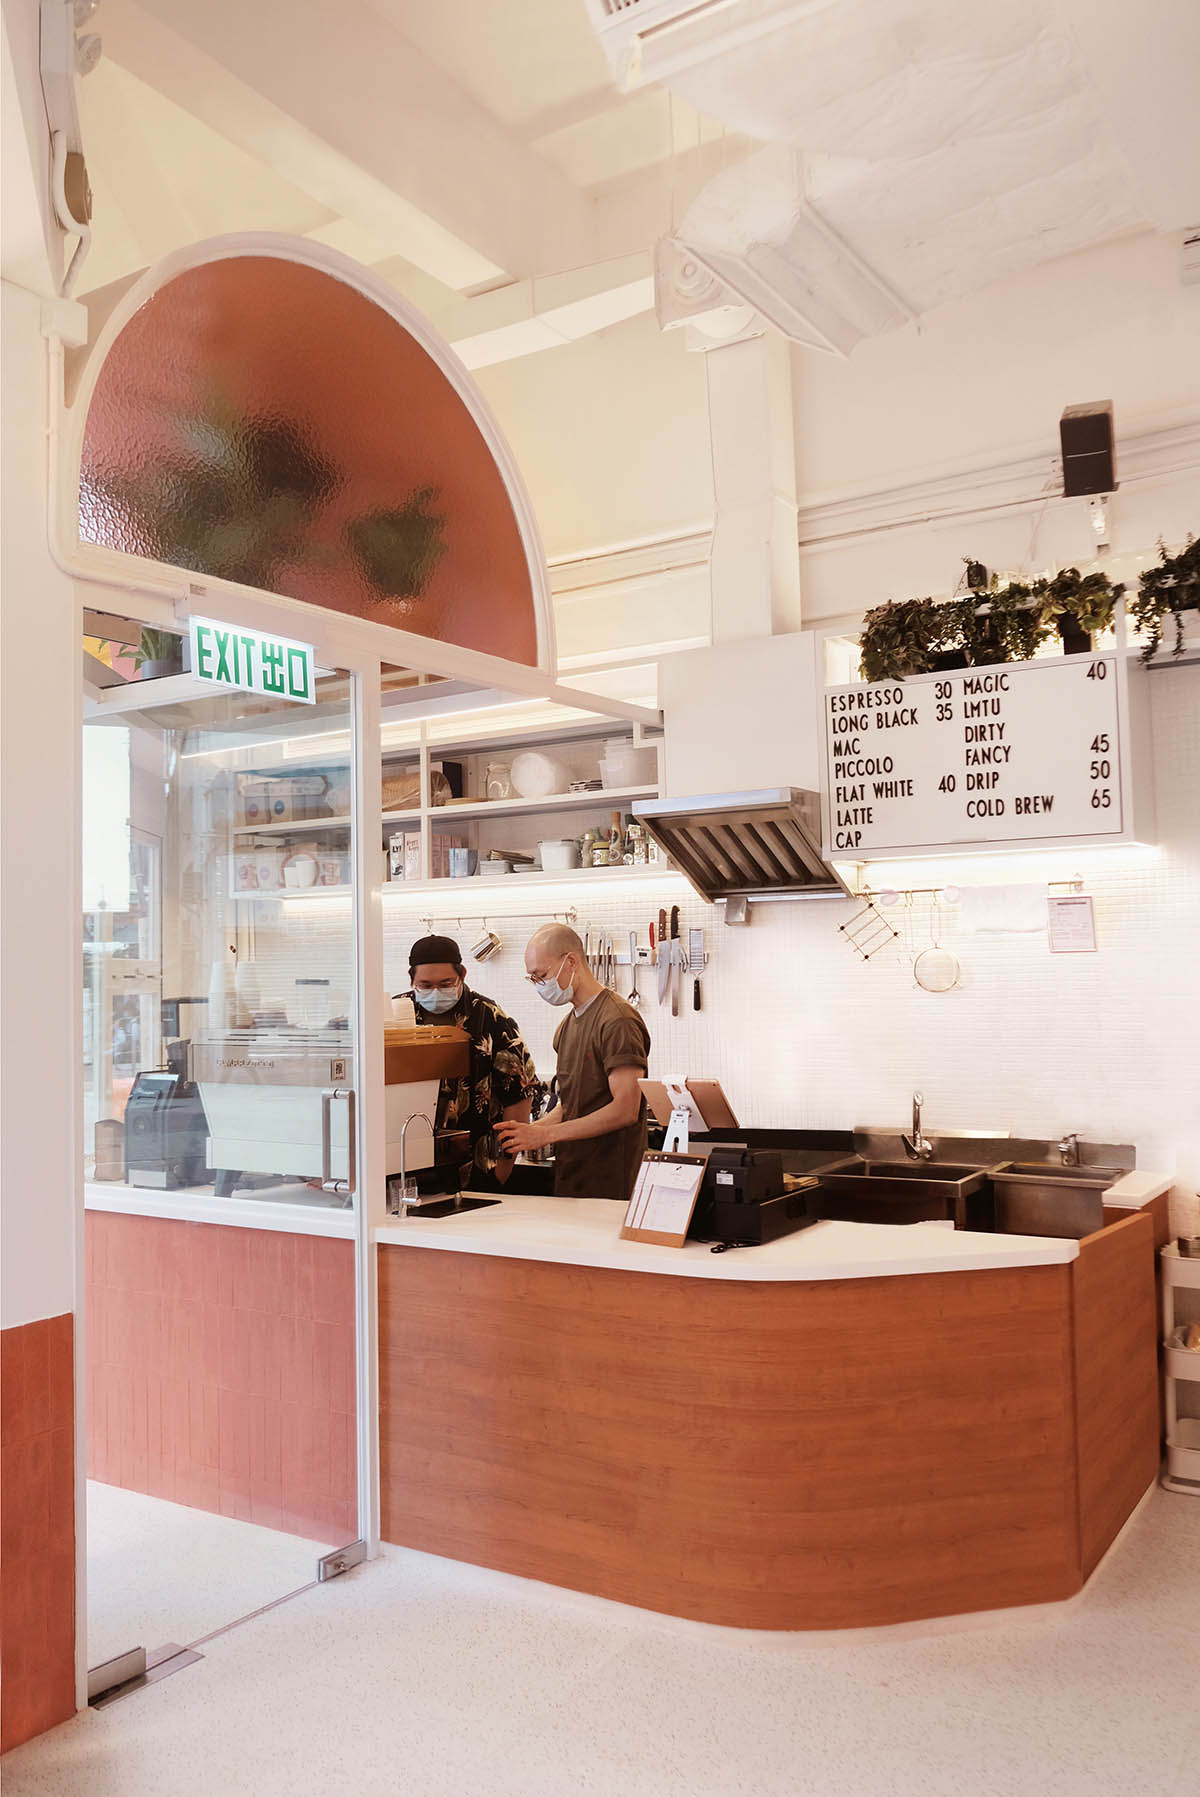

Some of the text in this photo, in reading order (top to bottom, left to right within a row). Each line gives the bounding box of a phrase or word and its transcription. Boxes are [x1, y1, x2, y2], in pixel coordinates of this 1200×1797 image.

[197, 626, 309, 699] EXIT 出口
[963, 661, 1107, 696] MAGIC 40
[830, 681, 953, 713] ESPRESSO 30
[963, 698, 1001, 719] LMTU
[831, 703, 953, 735] LONG BLACK 35
[964, 722, 1006, 744] DIRTY
[833, 738, 861, 758] MAC
[965, 733, 1110, 767] FANCY 45
[835, 756, 894, 780] PICCOLO
[966, 760, 1111, 792] DRIP 50
[836, 774, 956, 804] FLAT WHITE 40
[966, 788, 1111, 819] COLD BREW 65
[836, 807, 874, 828] LATTE
[835, 831, 862, 850] CAP
